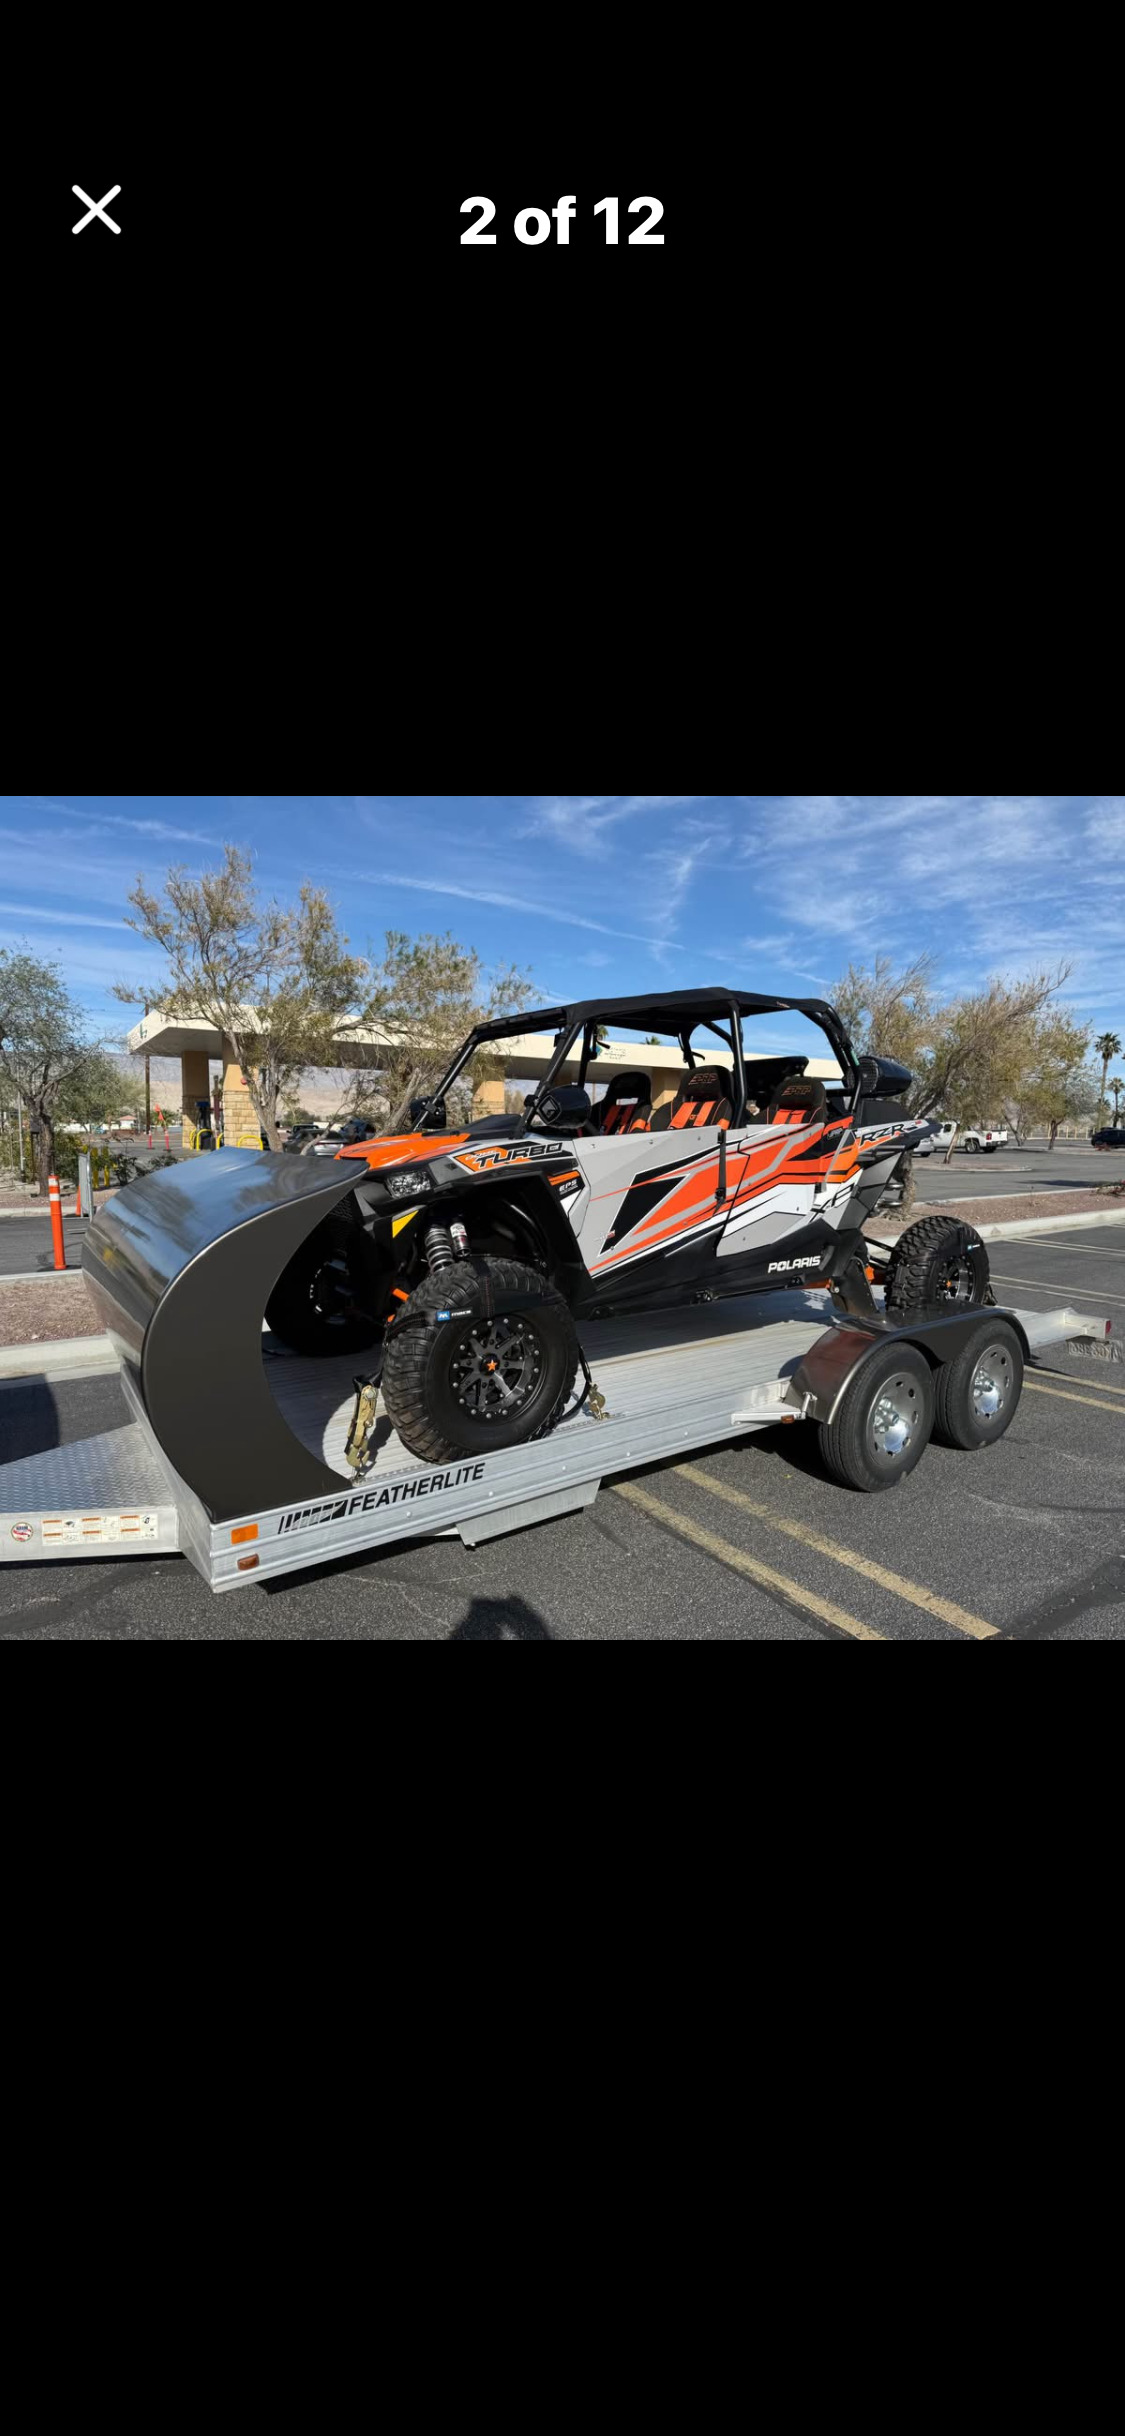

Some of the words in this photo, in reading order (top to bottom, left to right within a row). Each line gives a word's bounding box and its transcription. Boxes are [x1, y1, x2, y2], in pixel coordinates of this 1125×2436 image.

[860, 1123, 905, 1147] RZR
[475, 1142, 562, 1168] TURBO
[767, 1255, 822, 1274] POLARIS
[348, 1462, 486, 1516] FEATHERLITE
